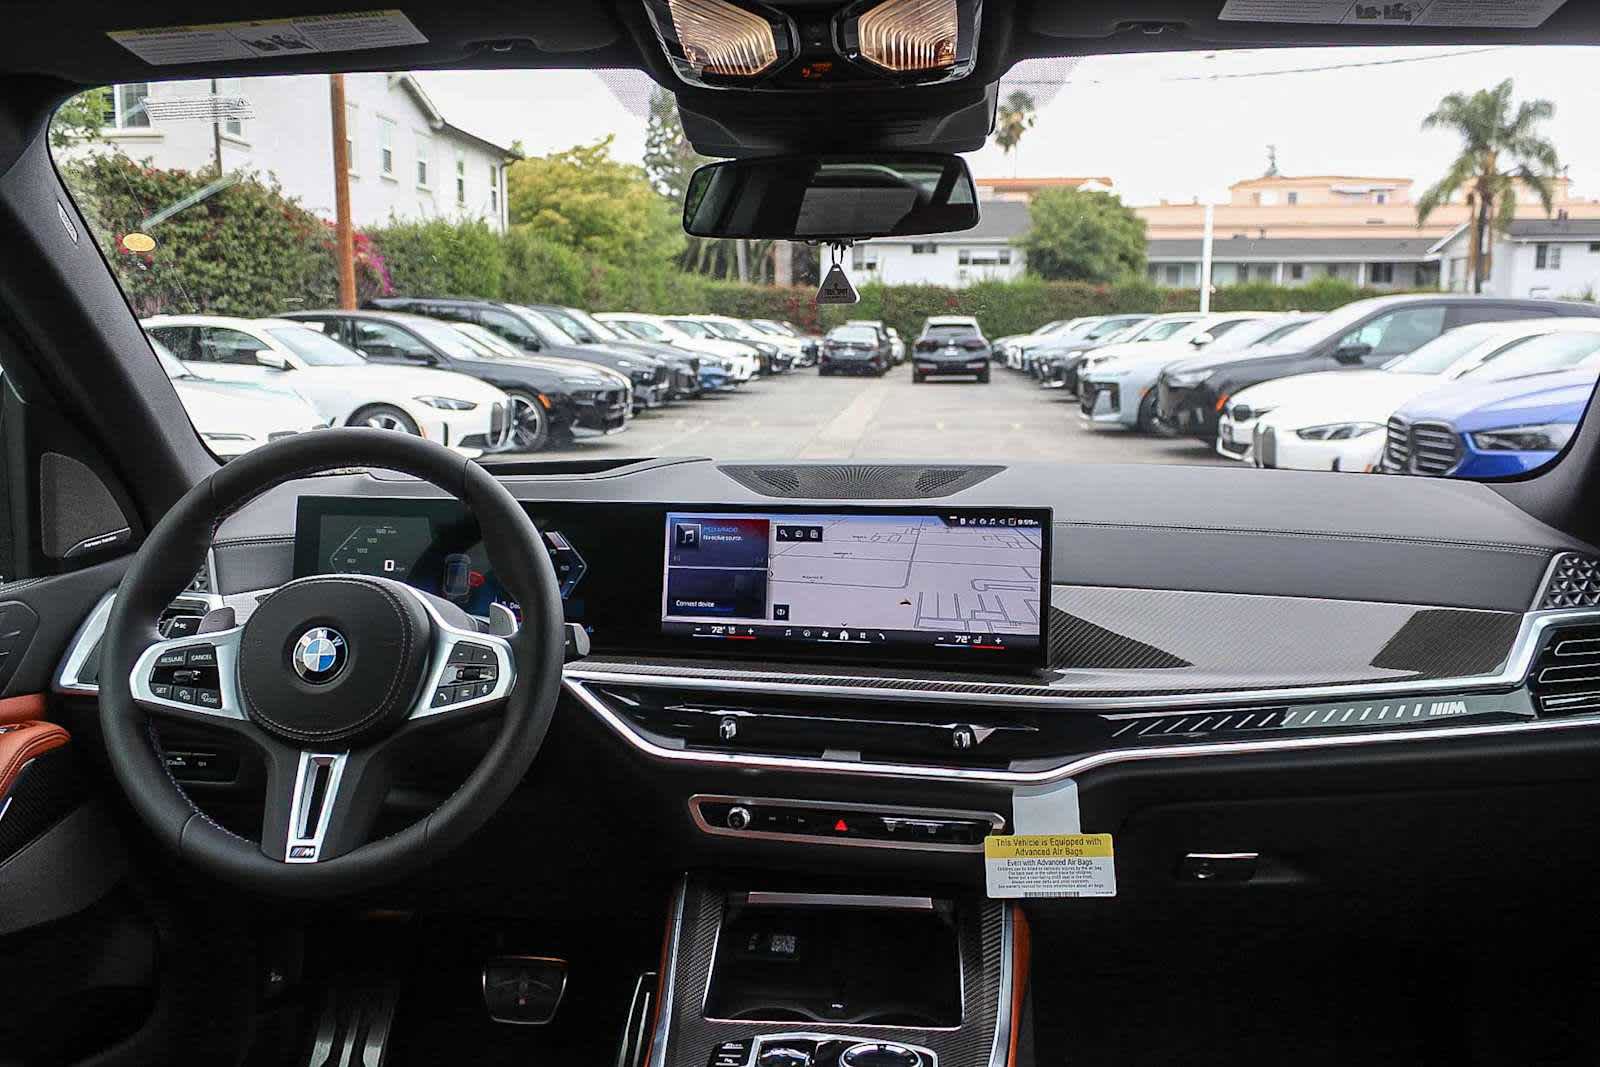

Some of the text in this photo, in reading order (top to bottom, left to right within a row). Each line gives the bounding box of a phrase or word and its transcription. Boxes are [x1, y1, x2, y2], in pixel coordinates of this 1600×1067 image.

[996, 838, 1011, 847] This
[1013, 838, 1039, 846] Vehicle
[1050, 838, 1084, 847] Equipped
[1085, 838, 1102, 846] with
[1015, 848, 1051, 856] Advanced
[1065, 848, 1083, 857] Bags
[1077, 859, 1093, 868] Bags
